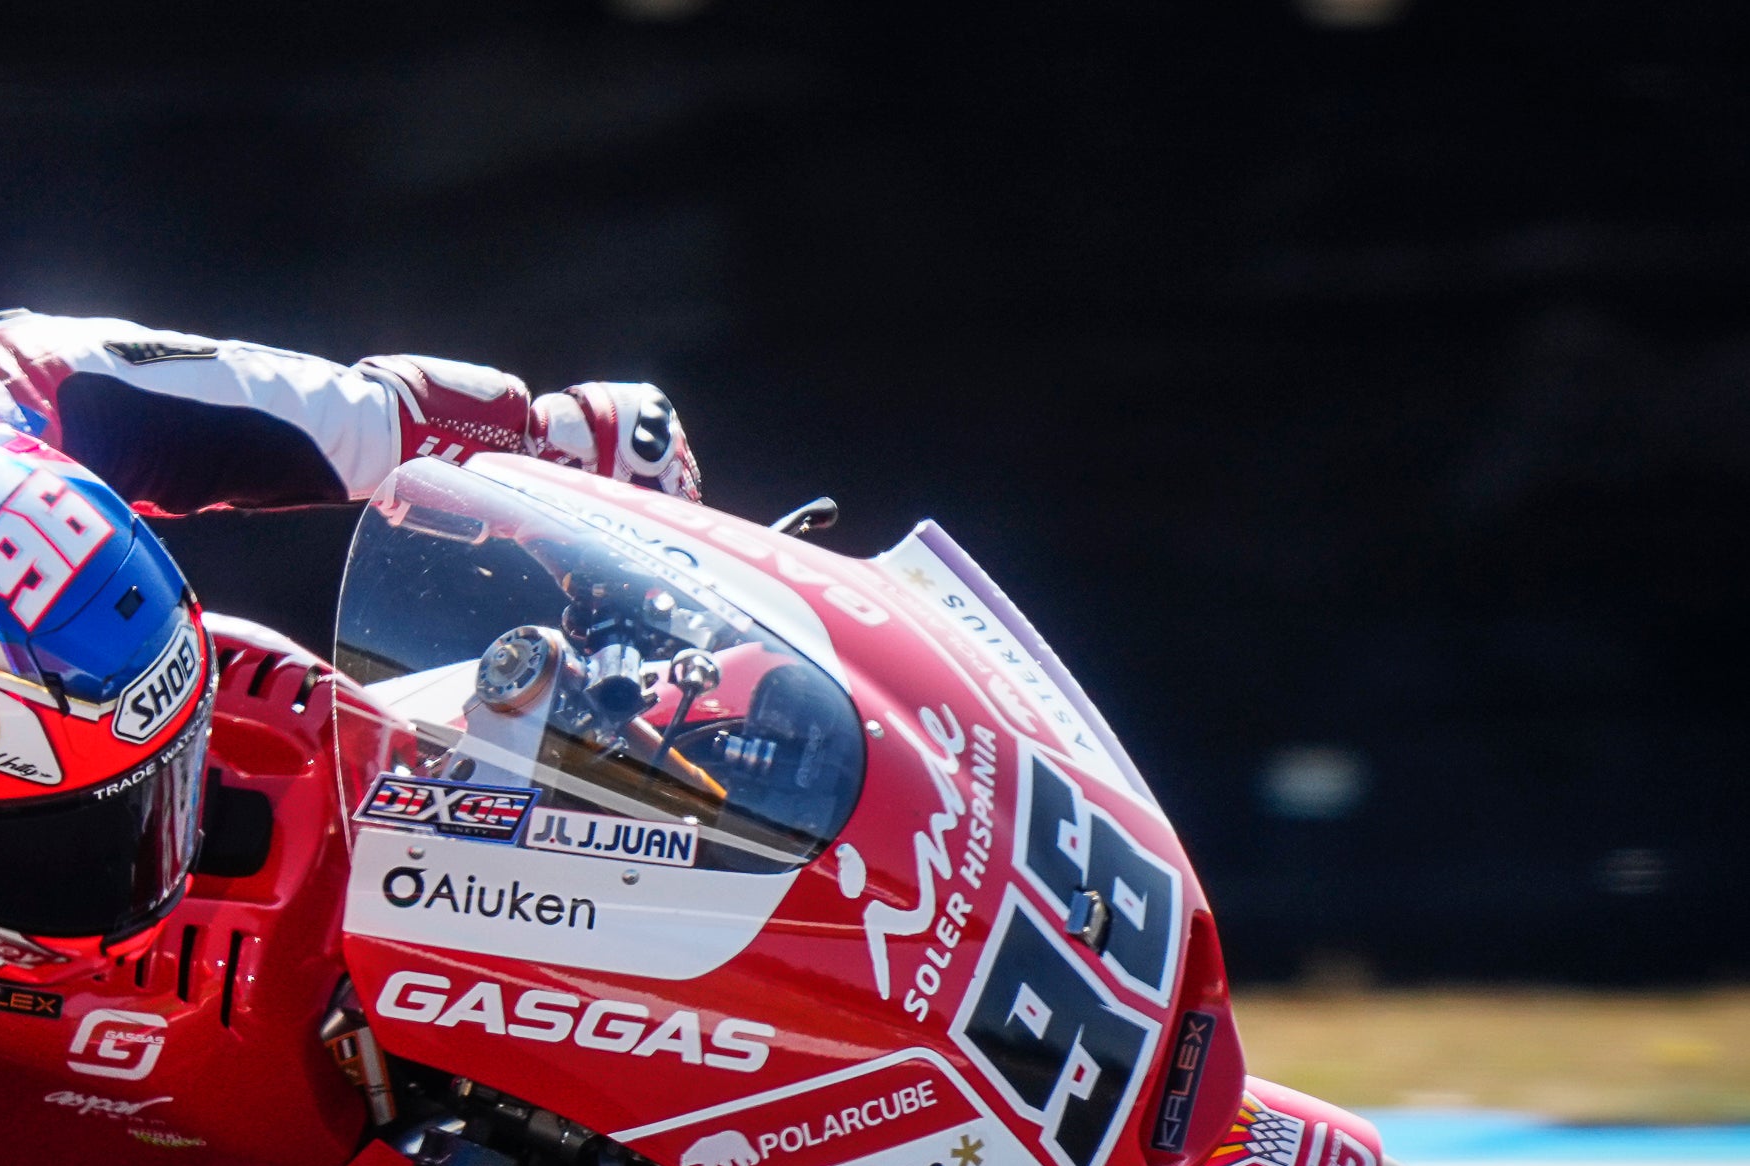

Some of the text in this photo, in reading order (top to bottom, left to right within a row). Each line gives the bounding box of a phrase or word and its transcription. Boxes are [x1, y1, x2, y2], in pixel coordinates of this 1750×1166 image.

[133, 637, 197, 732] SHOEI
[93, 764, 156, 800] TRADE
[371, 784, 526, 829] DIXON
[578, 820, 693, 861] J.JUAN
[905, 723, 998, 1022] SOLER HISPANIA
[376, 971, 776, 1073] GASGAS
[759, 1079, 937, 1158] POLARCUBE
[1157, 1019, 1208, 1148] KALEX
